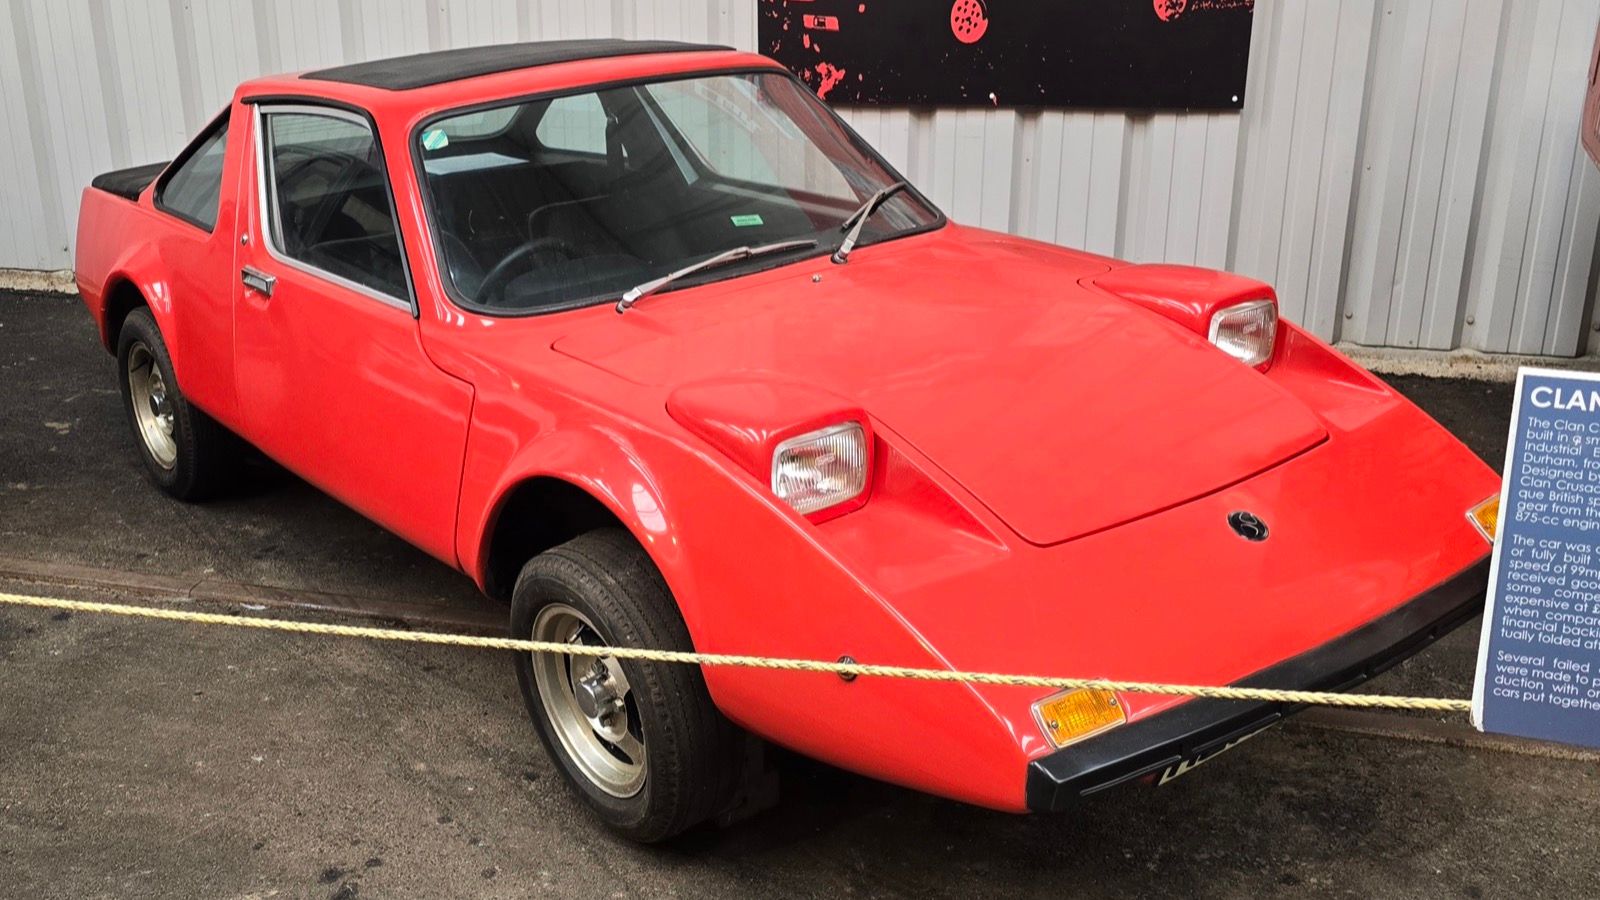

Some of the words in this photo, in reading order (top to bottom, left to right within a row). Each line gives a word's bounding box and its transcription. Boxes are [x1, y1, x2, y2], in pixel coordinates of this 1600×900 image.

[1528, 417, 1550, 428] The
[1554, 419, 1585, 432] Clan
[1526, 429, 1554, 440] built
[1557, 431, 1568, 442] in
[1524, 441, 1582, 456] Industrial
[1523, 452, 1578, 468] Durham,
[1522, 464, 1583, 480] Designed
[1520, 476, 1551, 488] Clan
[1518, 489, 1544, 500] que
[1549, 490, 1584, 504] British
[1517, 501, 1548, 512] gear
[1552, 502, 1581, 516] from
[1515, 511, 1559, 526] 875-cc
[1513, 534, 1535, 546] The
[1539, 539, 1561, 549] car
[1565, 542, 1591, 553] was
[1511, 548, 1524, 557] or
[1531, 548, 1556, 563] fully
[1563, 551, 1591, 565] built
[1509, 560, 1550, 572] speed
[1553, 564, 1567, 574] of
[1507, 571, 1566, 586] received
[1571, 579, 1600, 590] goo
[1506, 583, 1541, 595] some
[1505, 594, 1570, 610] expensive
[1574, 602, 1588, 613] at
[1503, 605, 1539, 618] when
[1545, 611, 1600, 625] compar
[1502, 615, 1558, 632] financial
[1562, 624, 1600, 638] backi
[1501, 627, 1535, 643] tually
[1538, 631, 1581, 647] folded
[1584, 639, 1600, 650] af
[1497, 650, 1545, 667] Several
[1553, 657, 1590, 673] failed
[1496, 664, 1528, 676] were
[1532, 668, 1571, 682] made
[1575, 673, 1589, 685] to
[1495, 674, 1544, 690] duction
[1552, 683, 1579, 695] with
[1493, 687, 1520, 699] cars
[1523, 691, 1545, 703] put
